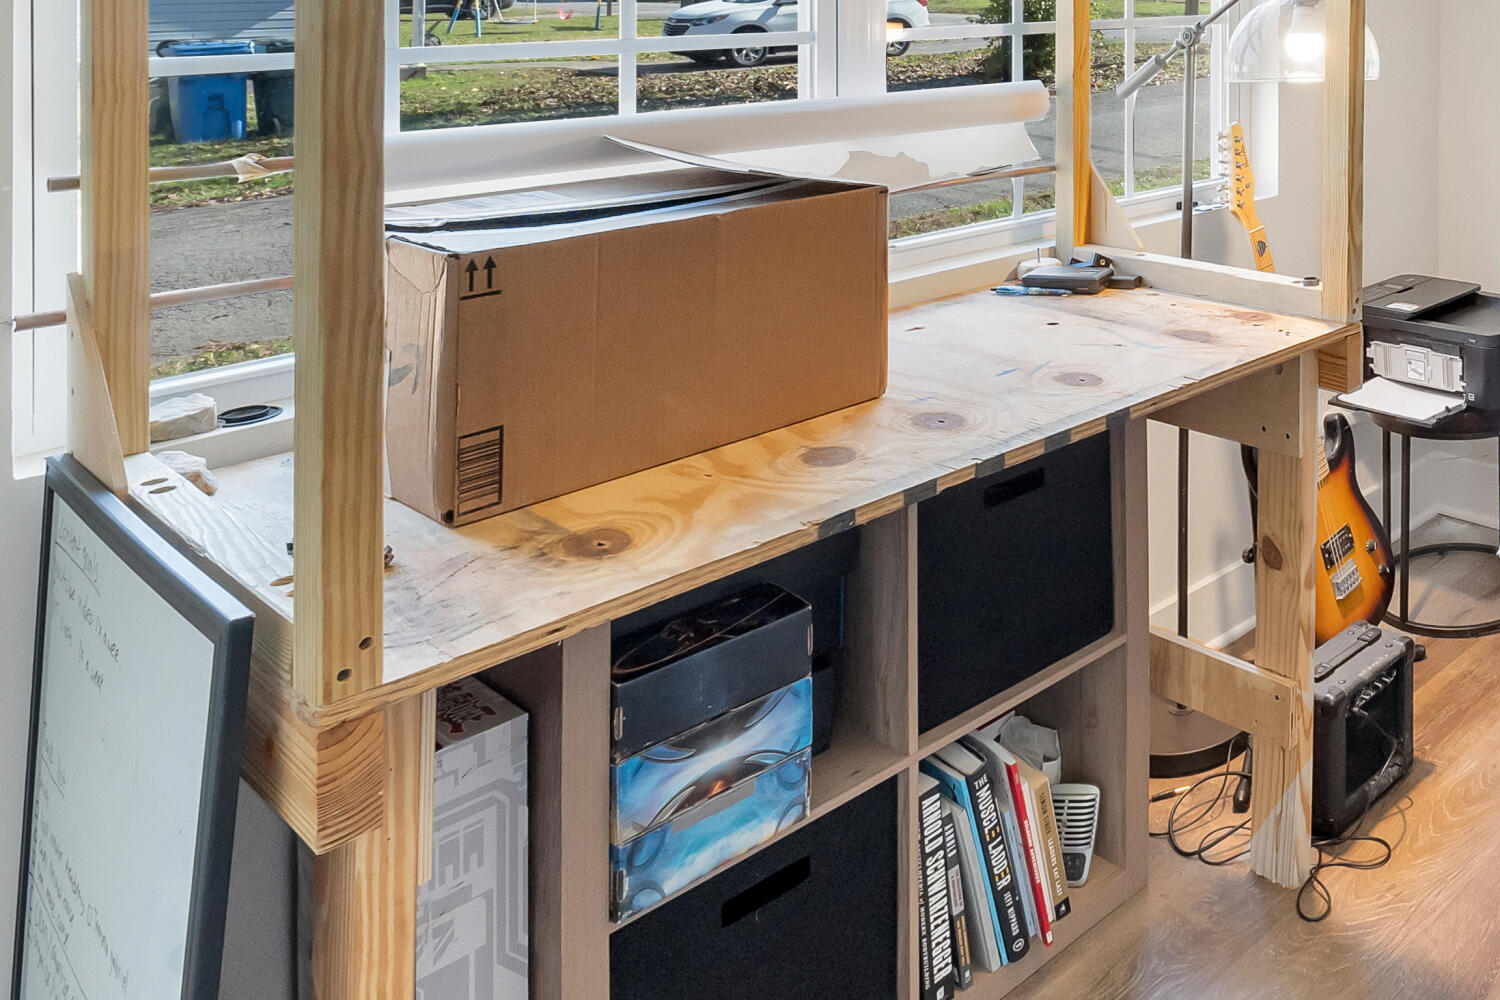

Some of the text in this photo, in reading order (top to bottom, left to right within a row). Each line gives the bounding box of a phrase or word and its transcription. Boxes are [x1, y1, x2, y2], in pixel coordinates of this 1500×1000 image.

[974, 772, 989, 790] THE
[944, 823, 957, 858] ARNOLD
[976, 783, 1011, 891] MUSCLE LADDER
[921, 792, 953, 984] ARNOLD SCHWARZENEGGER
[1047, 837, 1057, 866] LEADERS
[1055, 880, 1063, 896] LAST
[1003, 891, 1013, 907] JEFF
